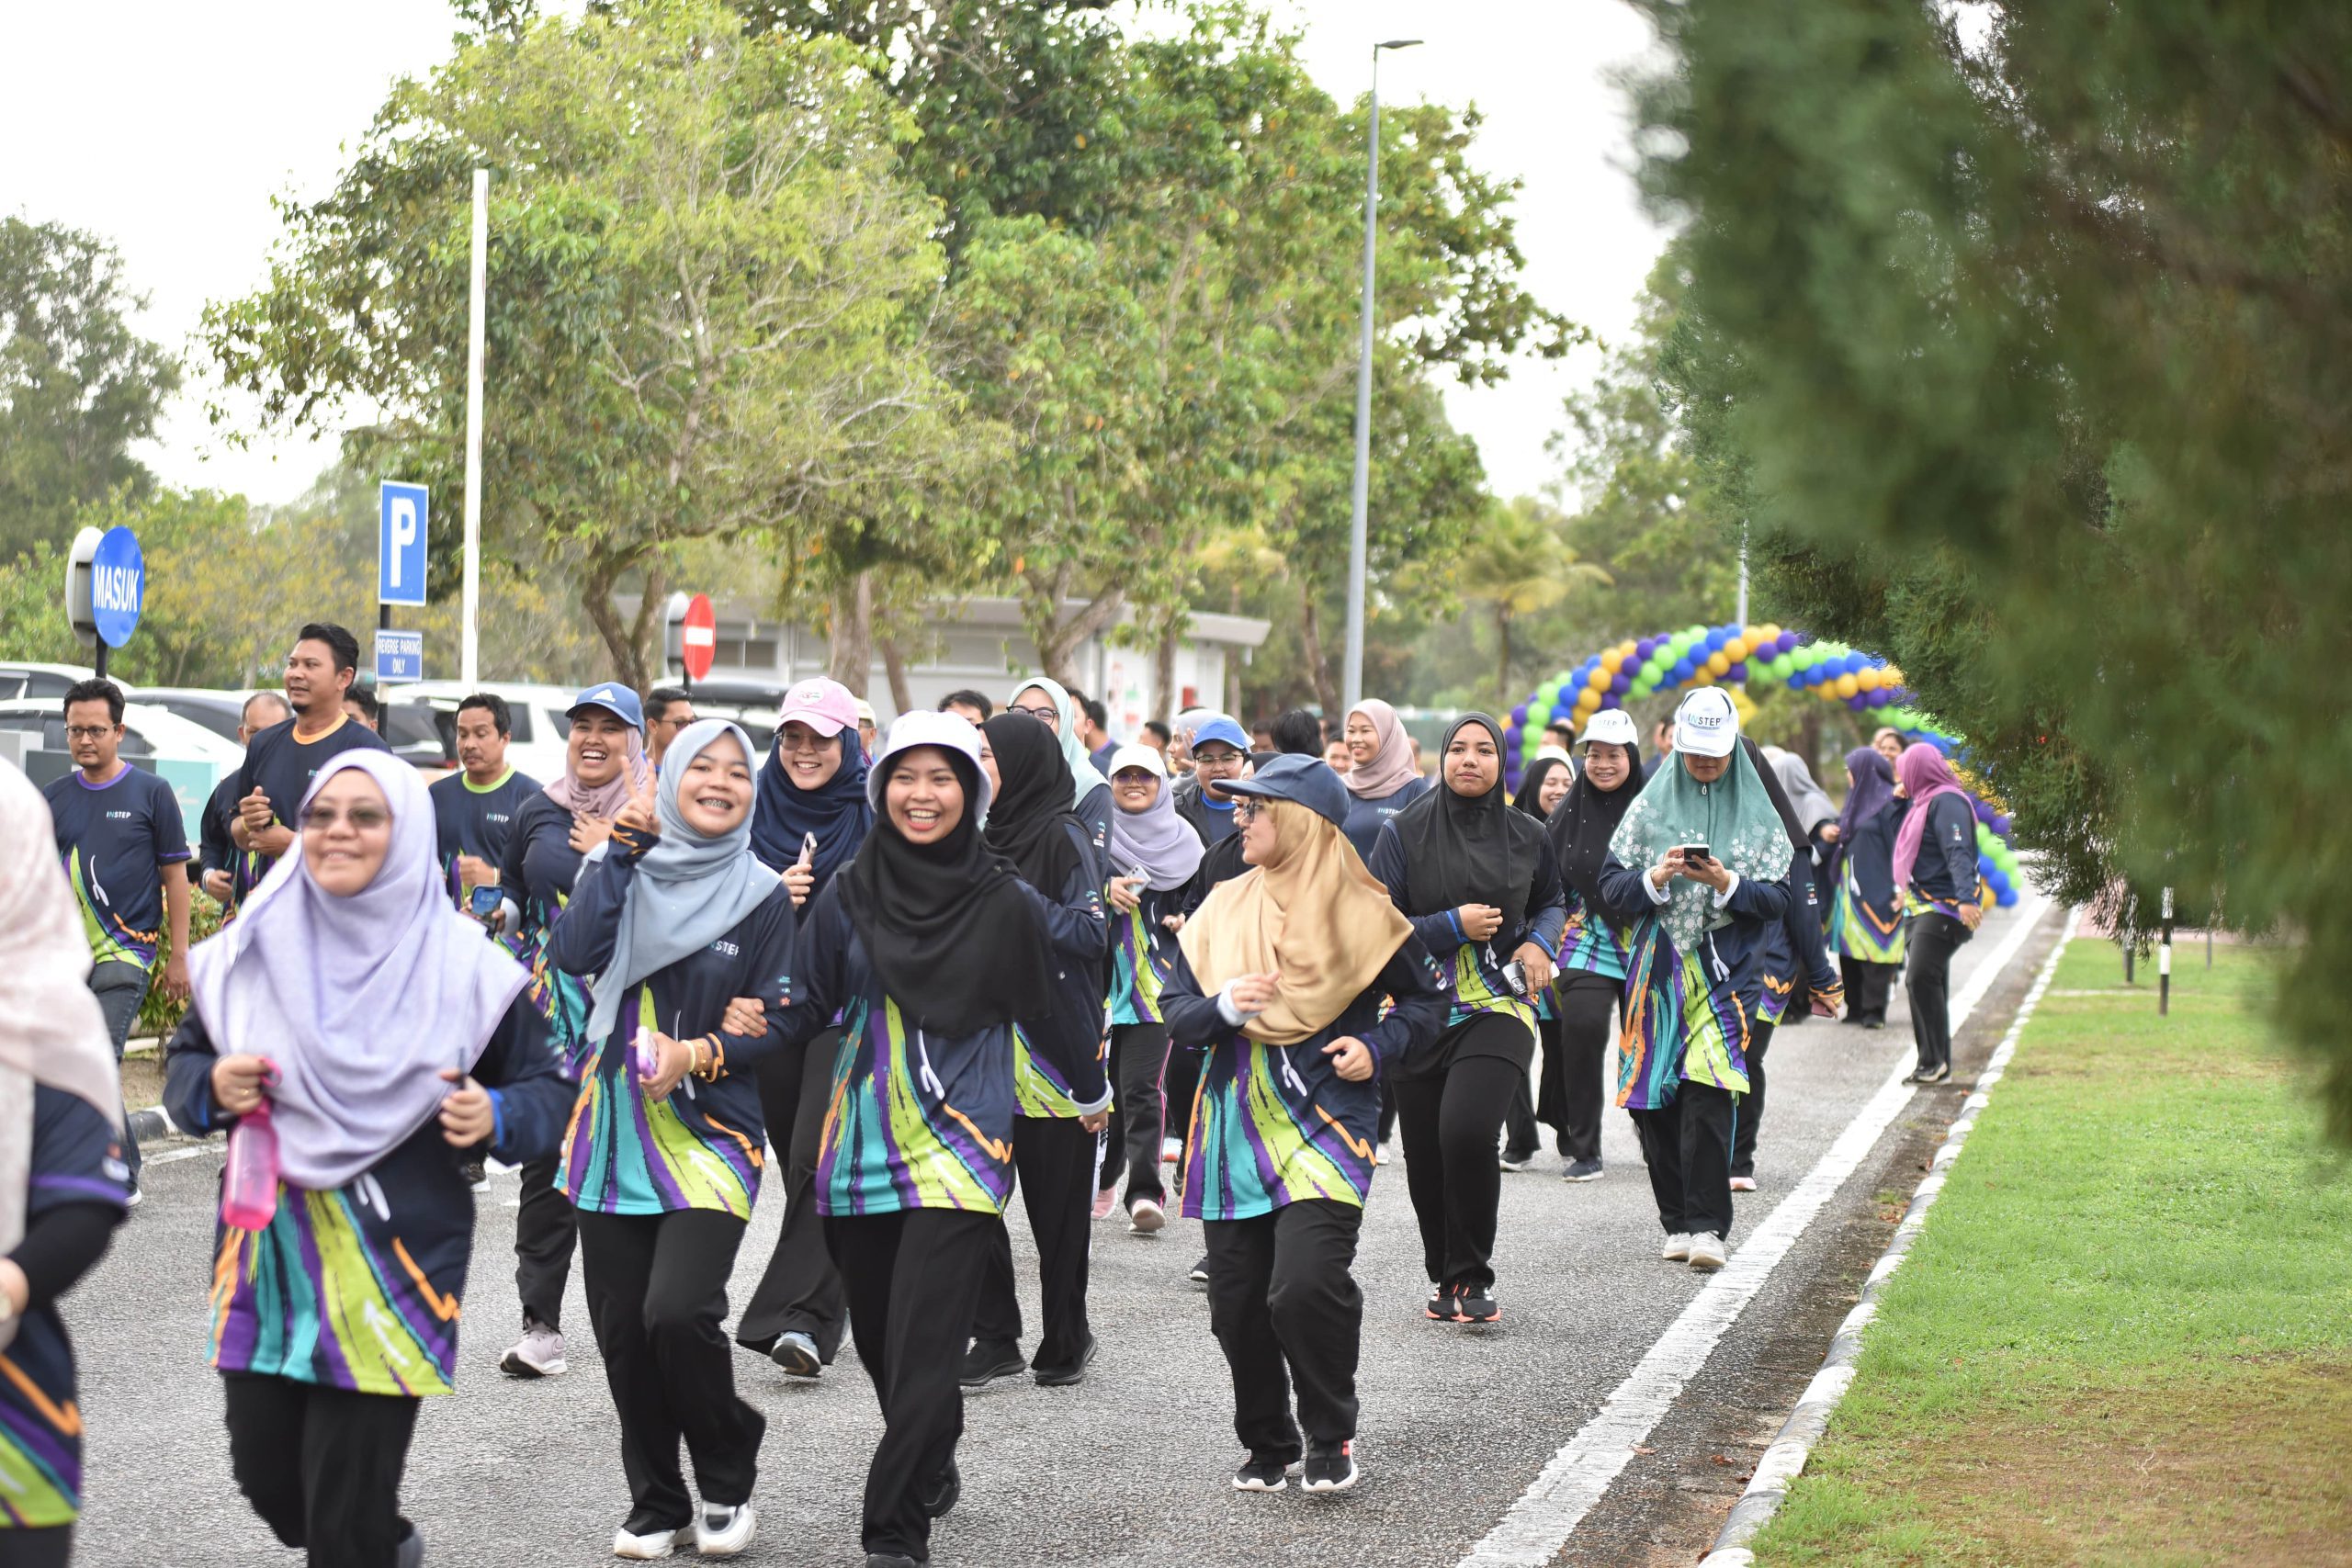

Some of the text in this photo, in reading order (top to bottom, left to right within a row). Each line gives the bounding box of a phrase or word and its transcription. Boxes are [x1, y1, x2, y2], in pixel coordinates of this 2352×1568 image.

[390, 497, 416, 588] P
[94, 564, 140, 614] MASUK
[378, 637, 421, 656] REVERSE PARKING
[392, 657, 406, 674] ONLY
[1688, 713, 1721, 727] INSTEP
[106, 810, 131, 818] INSTEP
[486, 813, 510, 823] INSTEP
